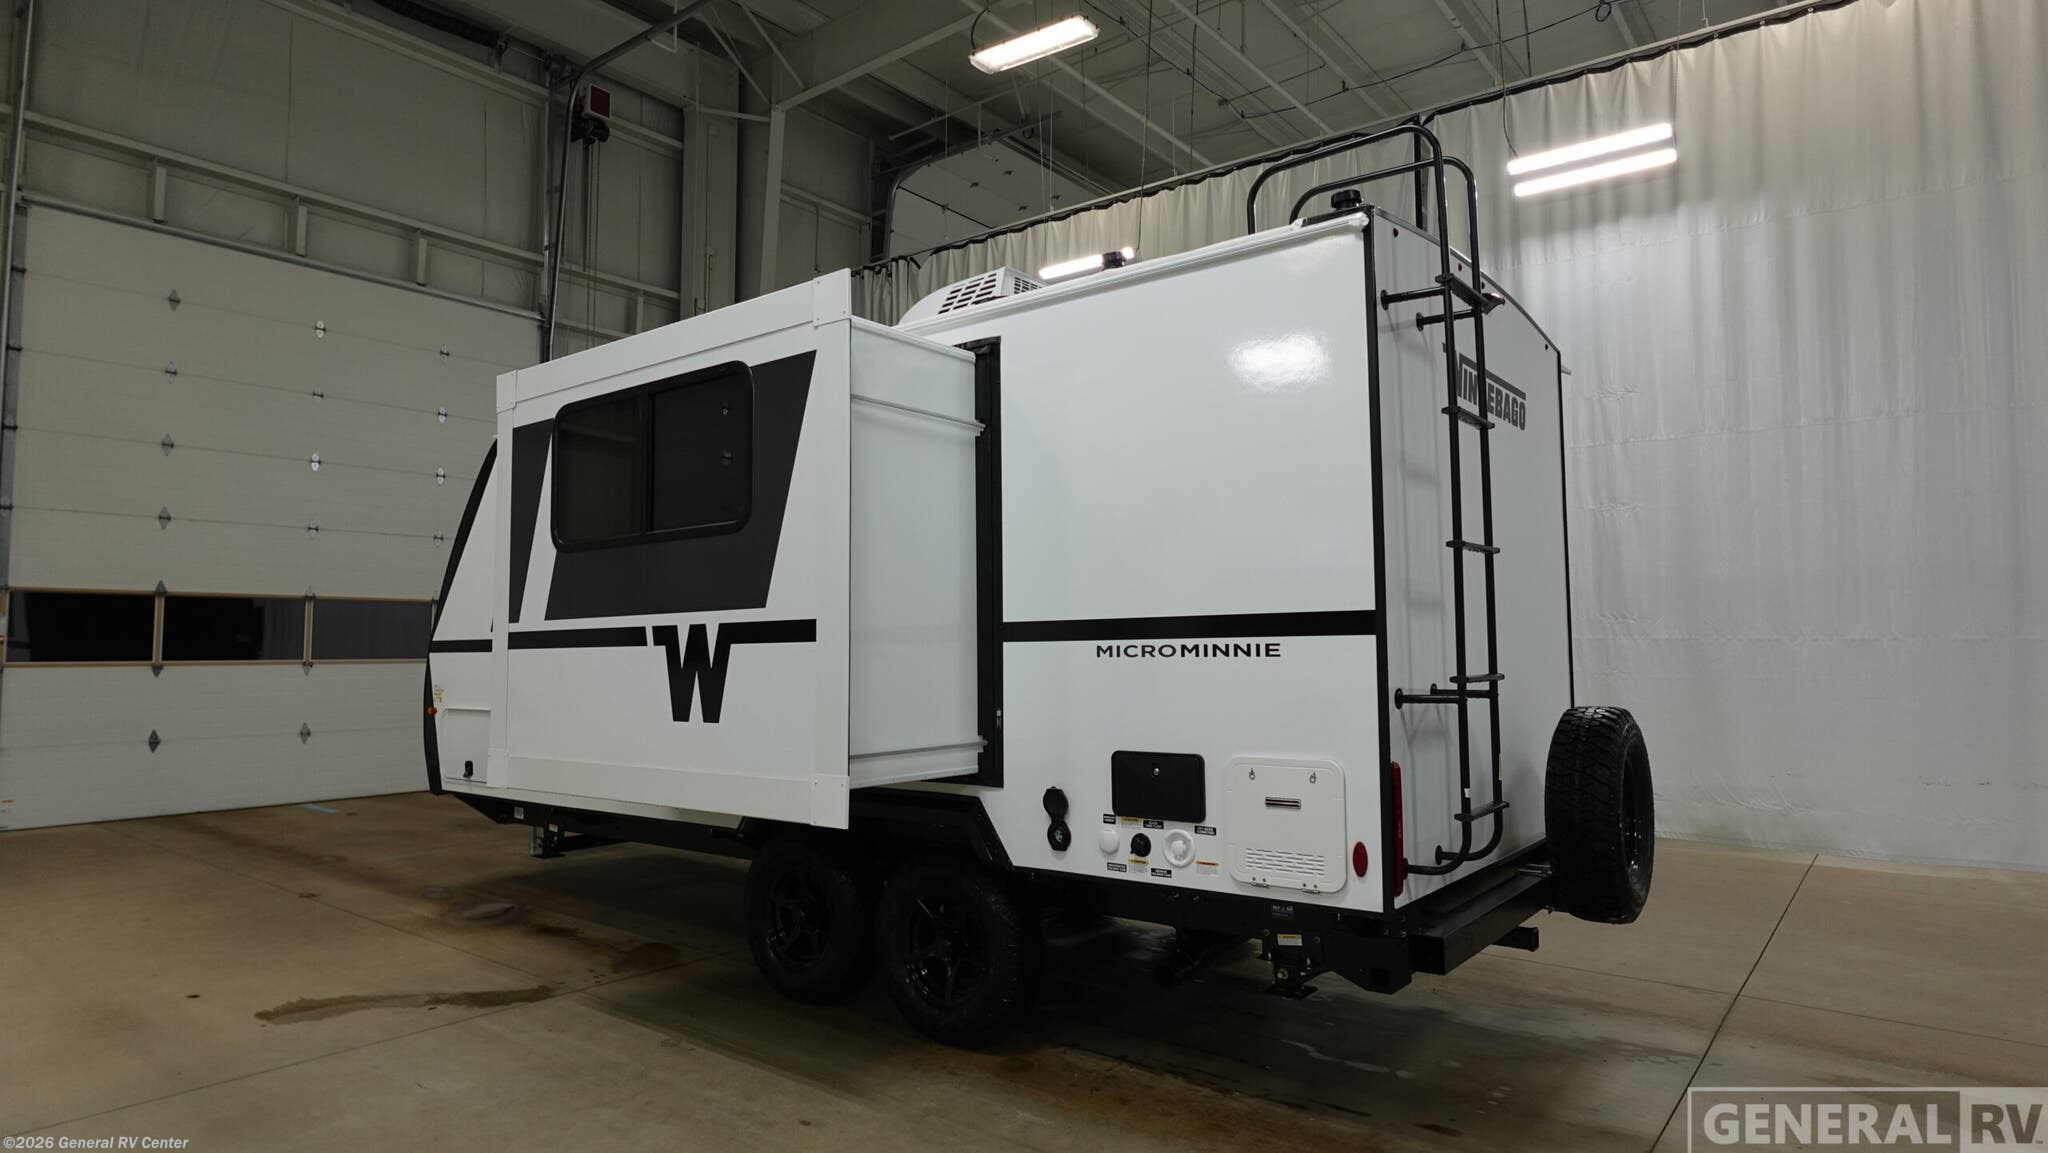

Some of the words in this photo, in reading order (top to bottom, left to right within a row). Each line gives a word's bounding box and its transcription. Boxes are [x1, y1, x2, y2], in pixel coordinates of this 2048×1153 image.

[1442, 342, 1526, 431] INEBAGO
[652, 623, 732, 724] W
[1096, 642, 1281, 658] MICROMINNIE
